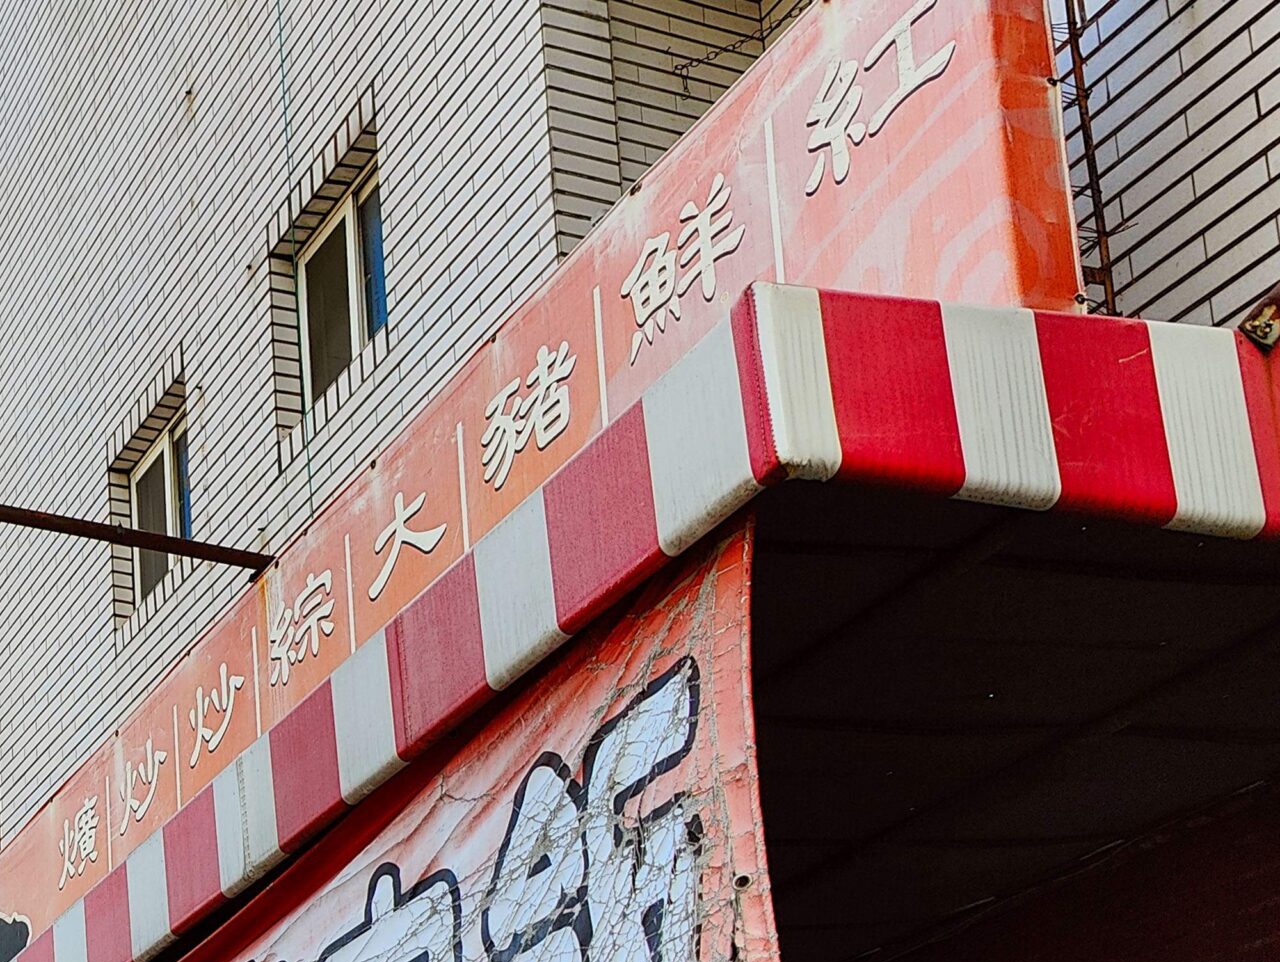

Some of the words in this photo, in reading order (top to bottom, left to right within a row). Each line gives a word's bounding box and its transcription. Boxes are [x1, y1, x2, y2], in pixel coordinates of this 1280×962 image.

[806, 0, 957, 197] 紅
[619, 172, 747, 367] 鮮
[479, 339, 578, 491] 豬
[367, 491, 449, 601] 大
[270, 568, 336, 687] 綜
[188, 662, 246, 769] 炒
[120, 737, 168, 836] 炒
